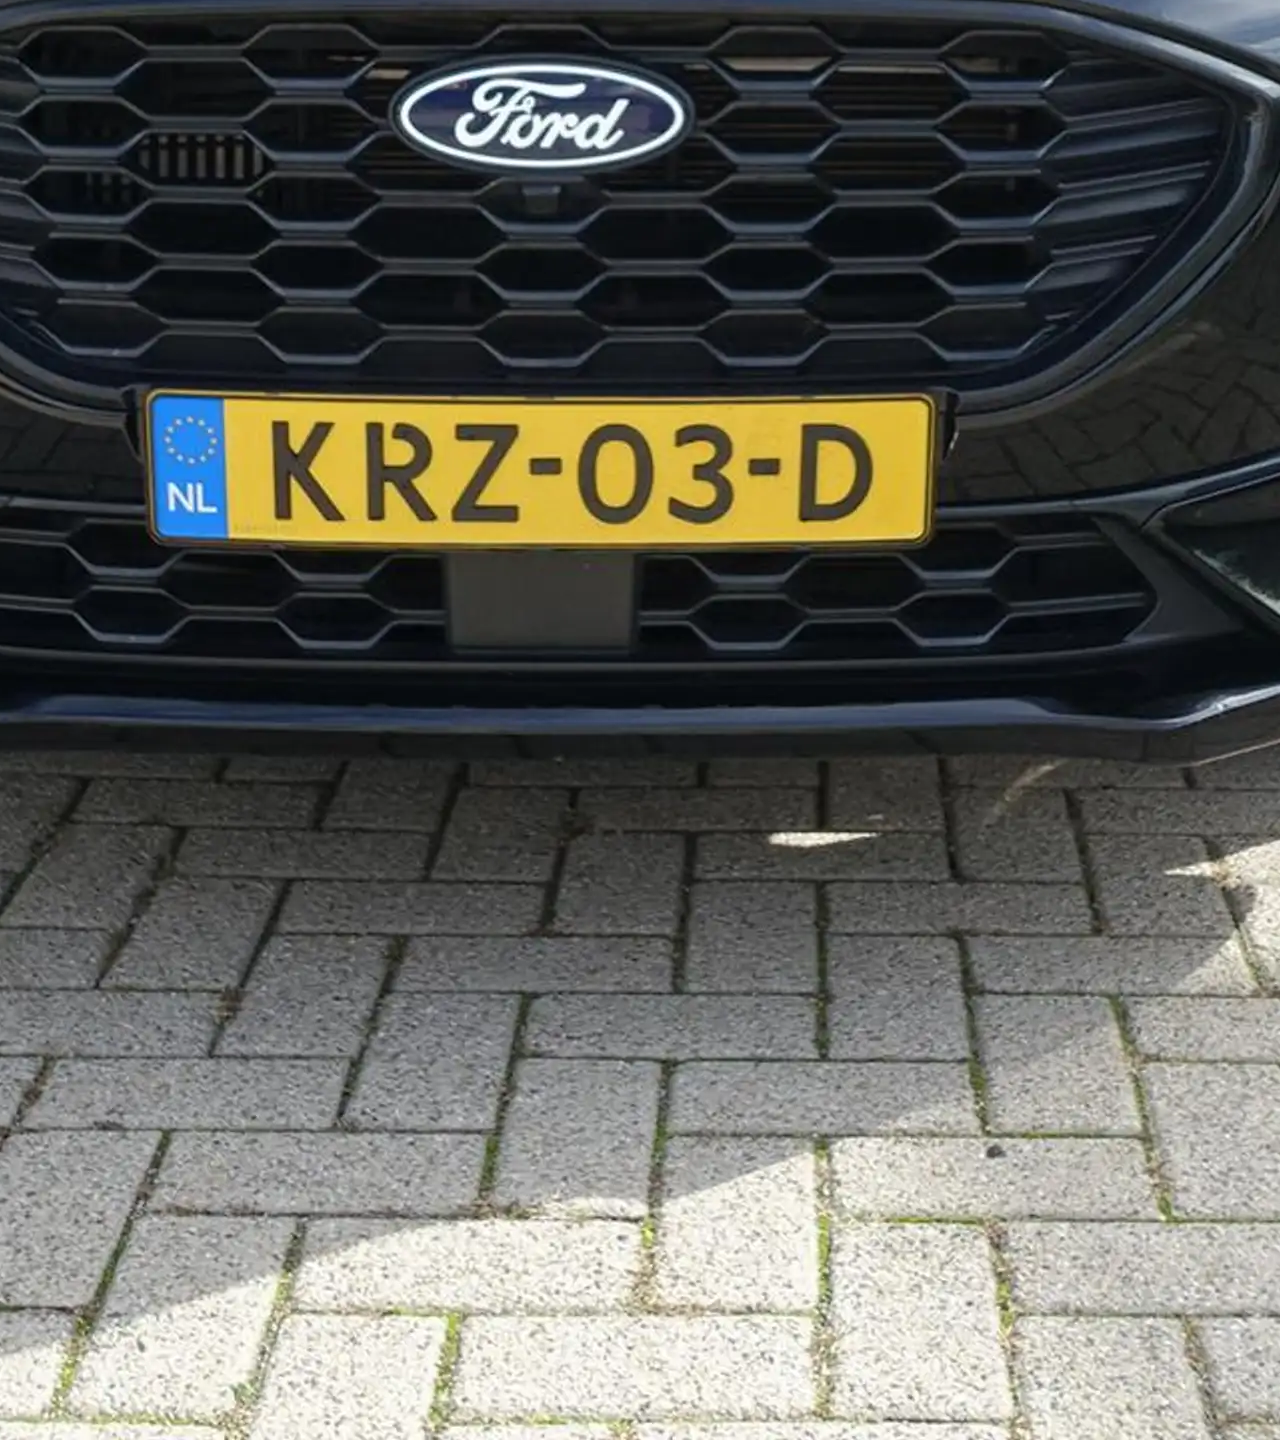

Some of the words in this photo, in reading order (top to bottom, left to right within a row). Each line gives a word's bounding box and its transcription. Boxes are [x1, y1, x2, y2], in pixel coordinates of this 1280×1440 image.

[455, 77, 629, 150] Ford
[168, 482, 218, 513] NL
[272, 420, 874, 525] KRZ-03-D
